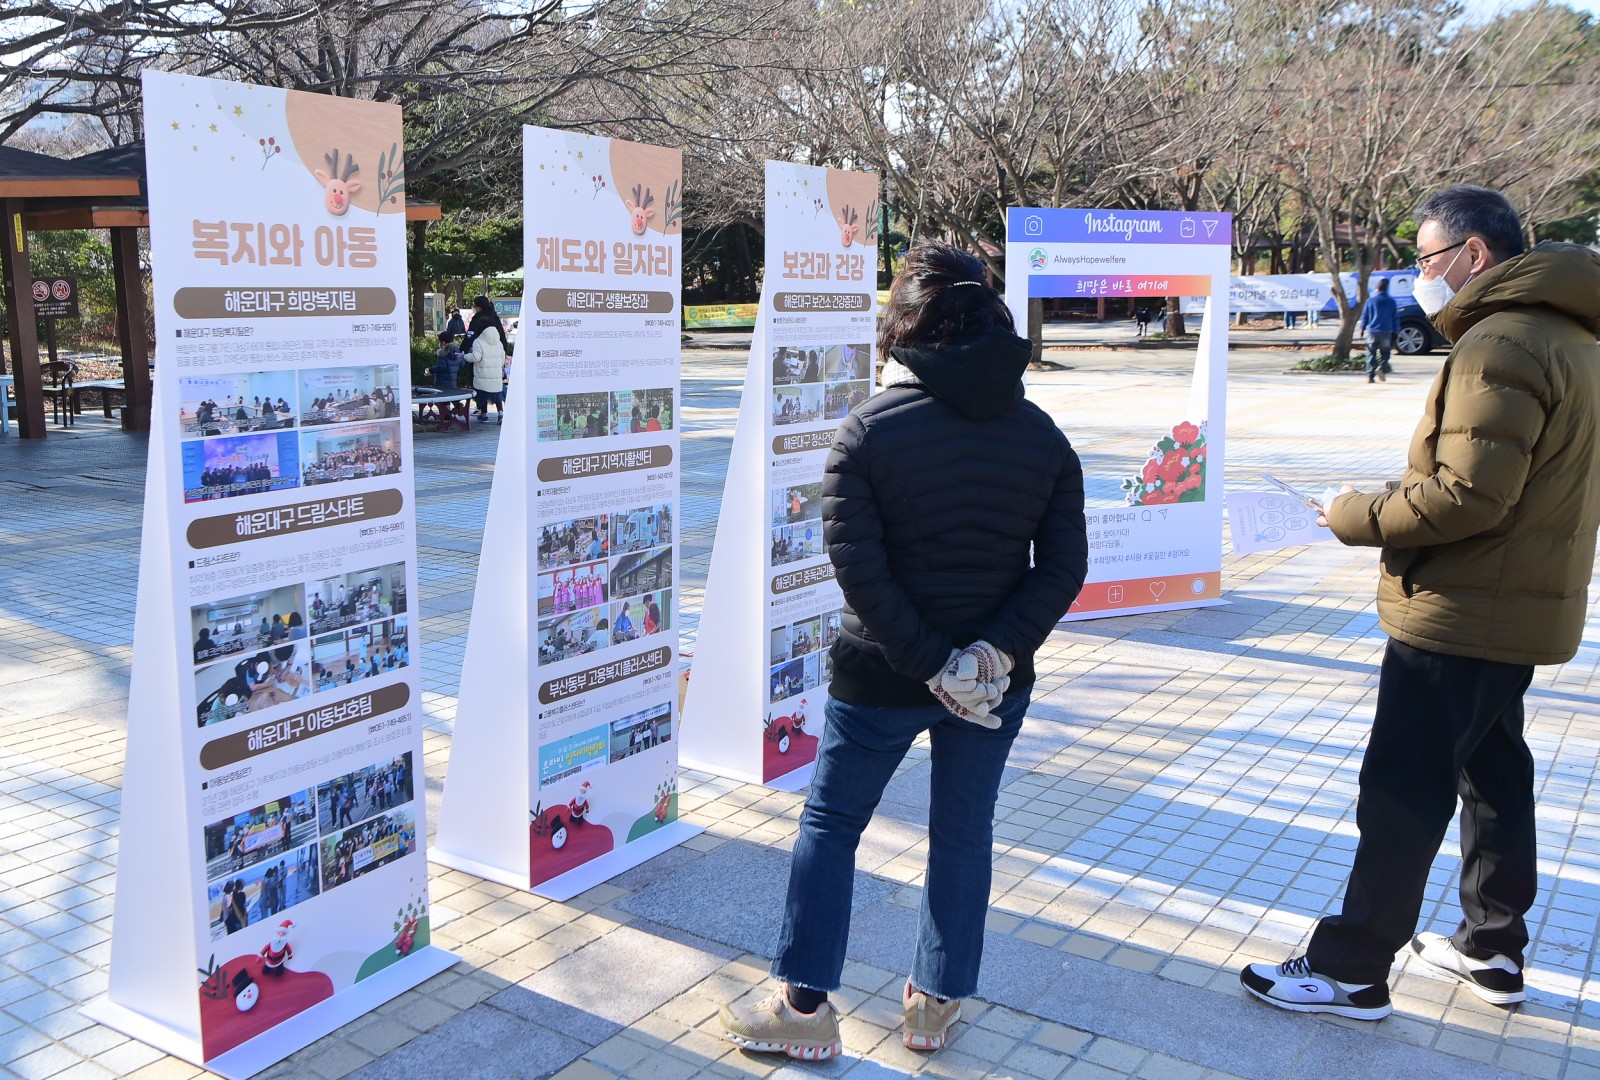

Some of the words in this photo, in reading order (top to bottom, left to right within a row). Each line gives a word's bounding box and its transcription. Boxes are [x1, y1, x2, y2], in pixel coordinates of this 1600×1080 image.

[1084, 212, 1163, 241] Instagram
[192, 219, 304, 266] 복지와
[314, 225, 378, 268] 아동
[536, 236, 607, 274] 제도와
[613, 242, 673, 277] 일자리
[783, 250, 831, 280] 보건과
[835, 253, 865, 281] 건강
[1054, 255, 1126, 265] AlwaysHopewelfere
[1076, 279, 1108, 294] 희망은
[1112, 279, 1133, 293] 바로
[1137, 280, 1169, 291] 여기에
[1238, 290, 1266, 300] 이겨낼
[1268, 289, 1278, 300] 수
[1280, 288, 1320, 300] 있습니다
[224, 291, 285, 312] 해운대구
[287, 291, 356, 311] 희망복지팀
[567, 291, 604, 308] 해운대구
[605, 292, 650, 309] 생활보장과
[784, 294, 811, 308] 해운대구
[811, 295, 832, 308] 보건소
[832, 295, 863, 309] 건강증진과
[783, 434, 811, 450] 해운대구
[563, 455, 600, 475] 해운대구
[601, 449, 652, 470] 지역자활센터
[235, 508, 295, 536] 해운대구
[297, 497, 364, 526] 드림스타트
[1102, 513, 1136, 524] 좋아합니다
[1103, 529, 1130, 539] 찾아가다!
[776, 571, 803, 591] 해운대구
[549, 673, 587, 698] 부산동부
[588, 650, 663, 687] 고용복지플러스센터
[247, 717, 305, 752] 해운대구
[307, 695, 373, 731] 아동보호팀
